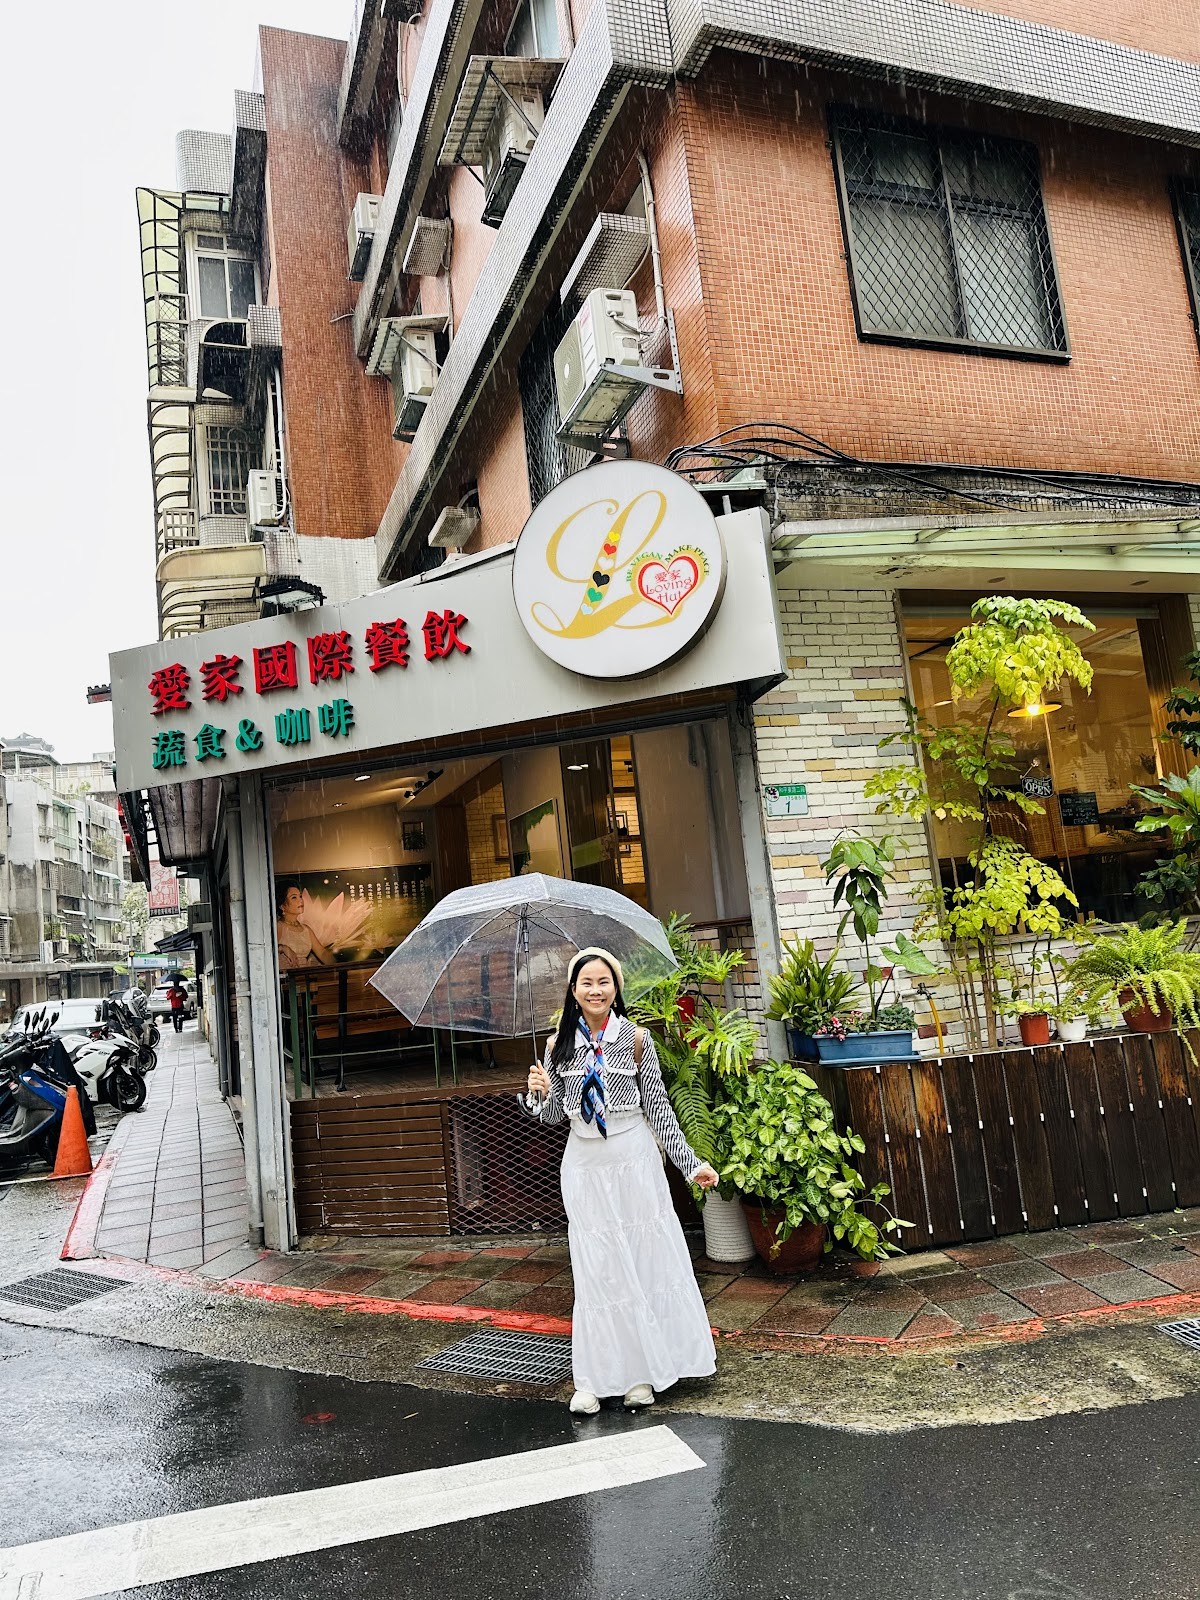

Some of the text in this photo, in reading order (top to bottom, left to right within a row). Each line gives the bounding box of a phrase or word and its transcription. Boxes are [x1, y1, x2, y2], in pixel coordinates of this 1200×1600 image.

[626, 551, 663, 582] BE VEGAN
[665, 544, 710, 576] MAKE PEACE
[654, 569, 681, 584] 愛家
[646, 576, 692, 595] Loving
[657, 590, 682, 604] Hut
[148, 609, 471, 715] 愛家國際餐飲
[1025, 780, 1052, 796] OPEN
[785, 801, 791, 813] 1
